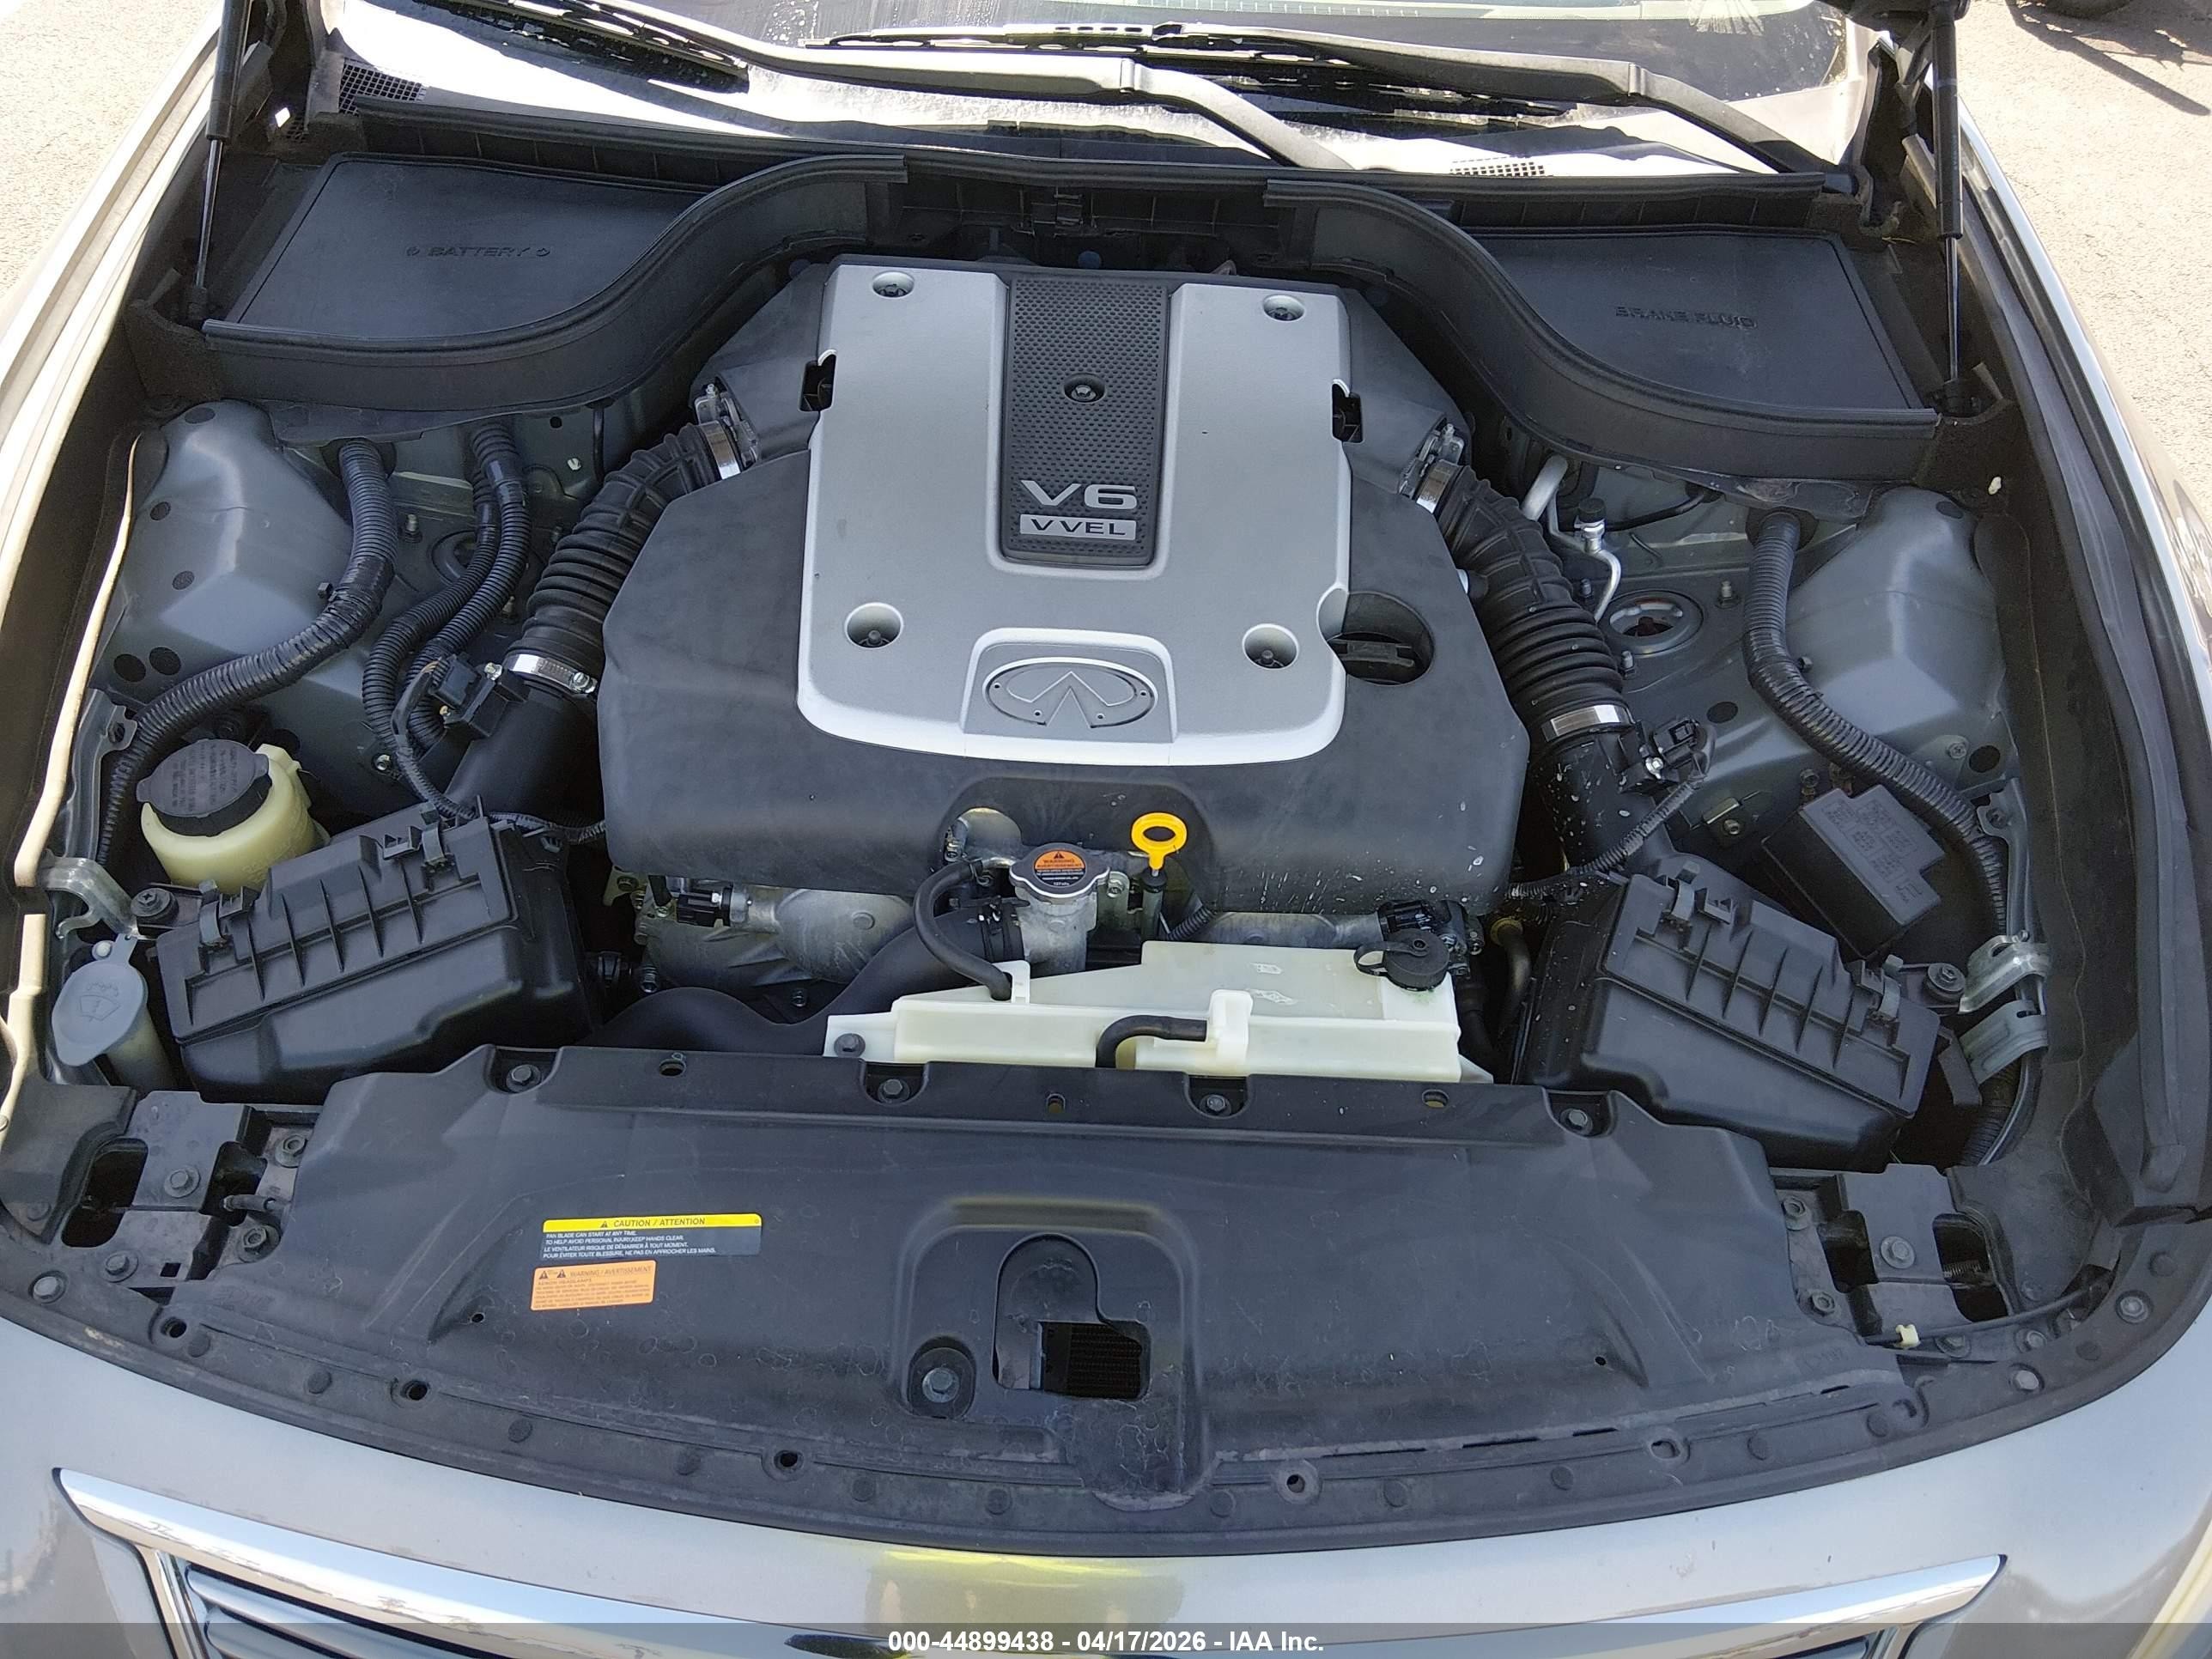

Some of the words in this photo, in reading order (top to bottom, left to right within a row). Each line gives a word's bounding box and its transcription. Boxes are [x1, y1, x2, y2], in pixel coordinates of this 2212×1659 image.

[428, 246, 530, 257] BATTERY
[1615, 306, 1689, 323] BRAKE
[1694, 312, 1757, 330] FLUID
[1020, 480, 1138, 510] V6
[1030, 518, 1127, 536] VVEL
[604, 1266, 652, 1276] AVERTISSEMENT
